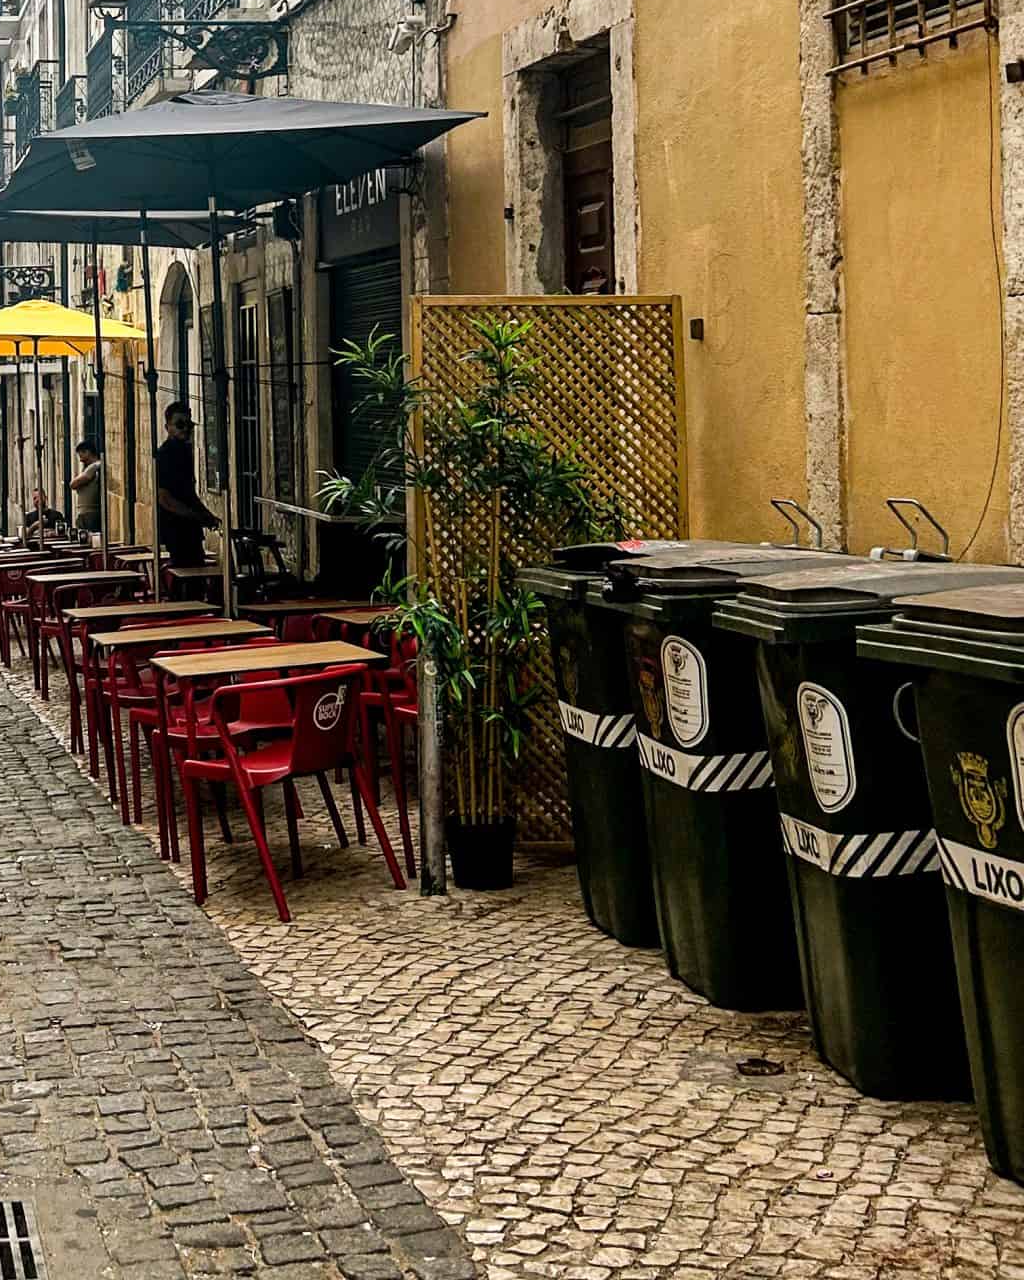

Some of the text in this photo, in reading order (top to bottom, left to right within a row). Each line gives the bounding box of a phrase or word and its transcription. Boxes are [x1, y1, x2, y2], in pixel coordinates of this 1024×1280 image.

[335, 168, 386, 216] ELEVEN
[566, 708, 584, 734] LIXO
[651, 745, 675, 776] LIXO
[972, 857, 1024, 902] LIXO
